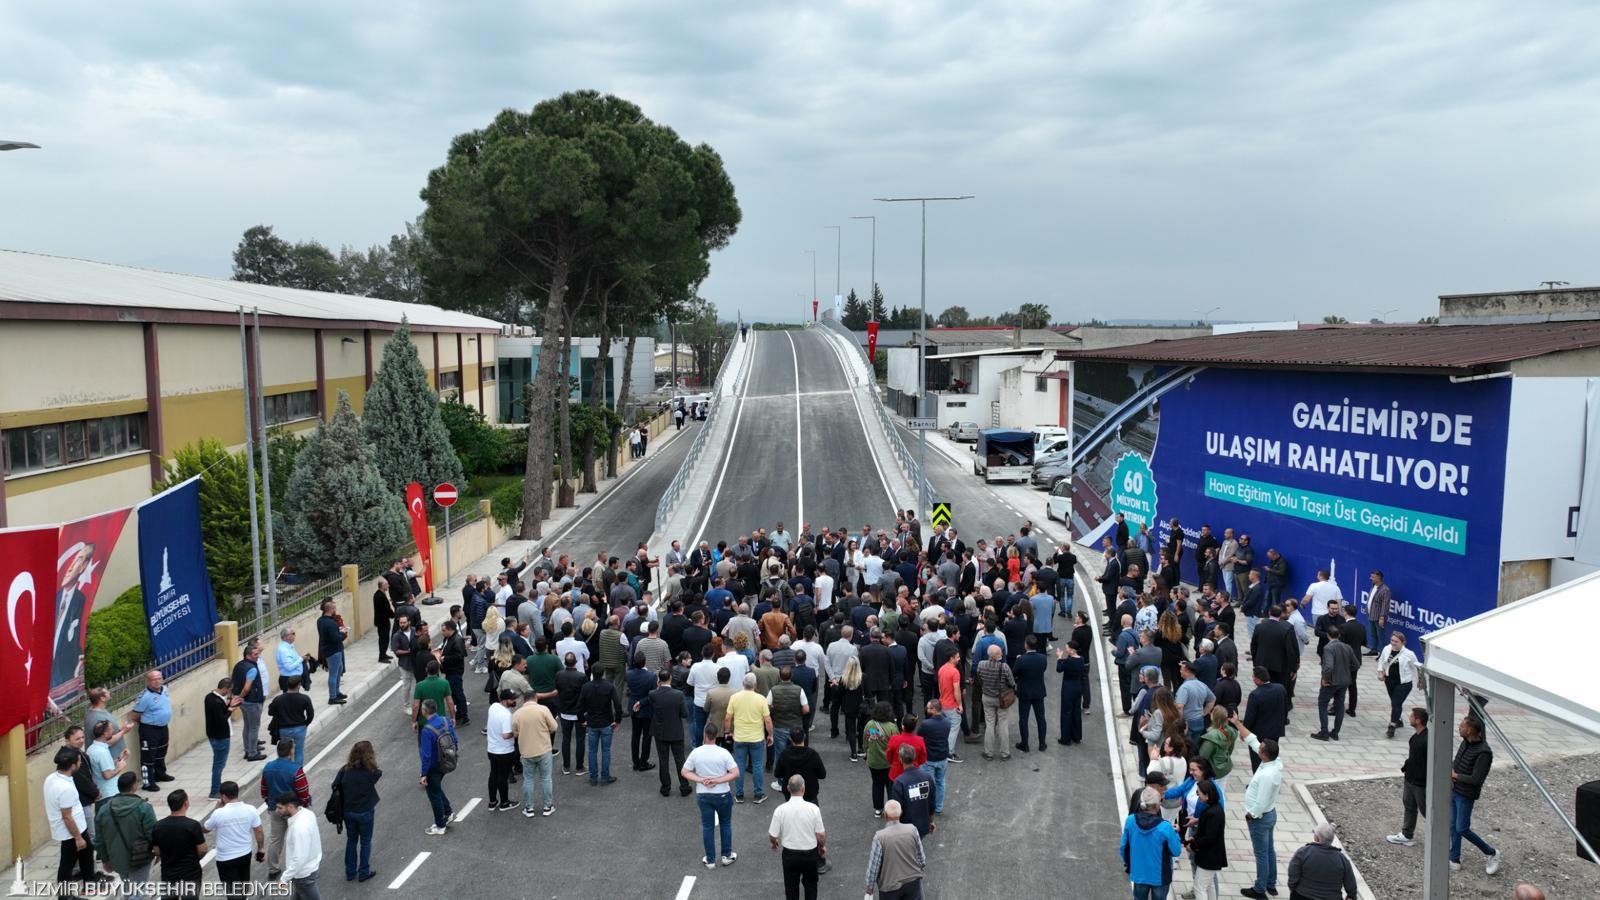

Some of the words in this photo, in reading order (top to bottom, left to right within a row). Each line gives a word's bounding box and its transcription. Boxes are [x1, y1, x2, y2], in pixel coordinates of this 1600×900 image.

[1292, 397, 1473, 446] GAZİEMİR’DE
[1206, 431, 1281, 466] ULAŞIM
[1288, 442, 1470, 496] RAHATLIYOR!
[1123, 470, 1143, 495] 60
[1116, 493, 1141, 510] MİLYON
[1142, 500, 1150, 512] TL
[1209, 477, 1236, 495] Hava
[1238, 483, 1272, 503] Eğitim
[1274, 490, 1298, 509] Yolu
[1301, 496, 1331, 517] Taşıt
[1334, 499, 1357, 522] Üst
[1360, 508, 1409, 533] Geçidi
[1411, 519, 1459, 545] Açıldı
[1388, 598, 1415, 620] EMİL
